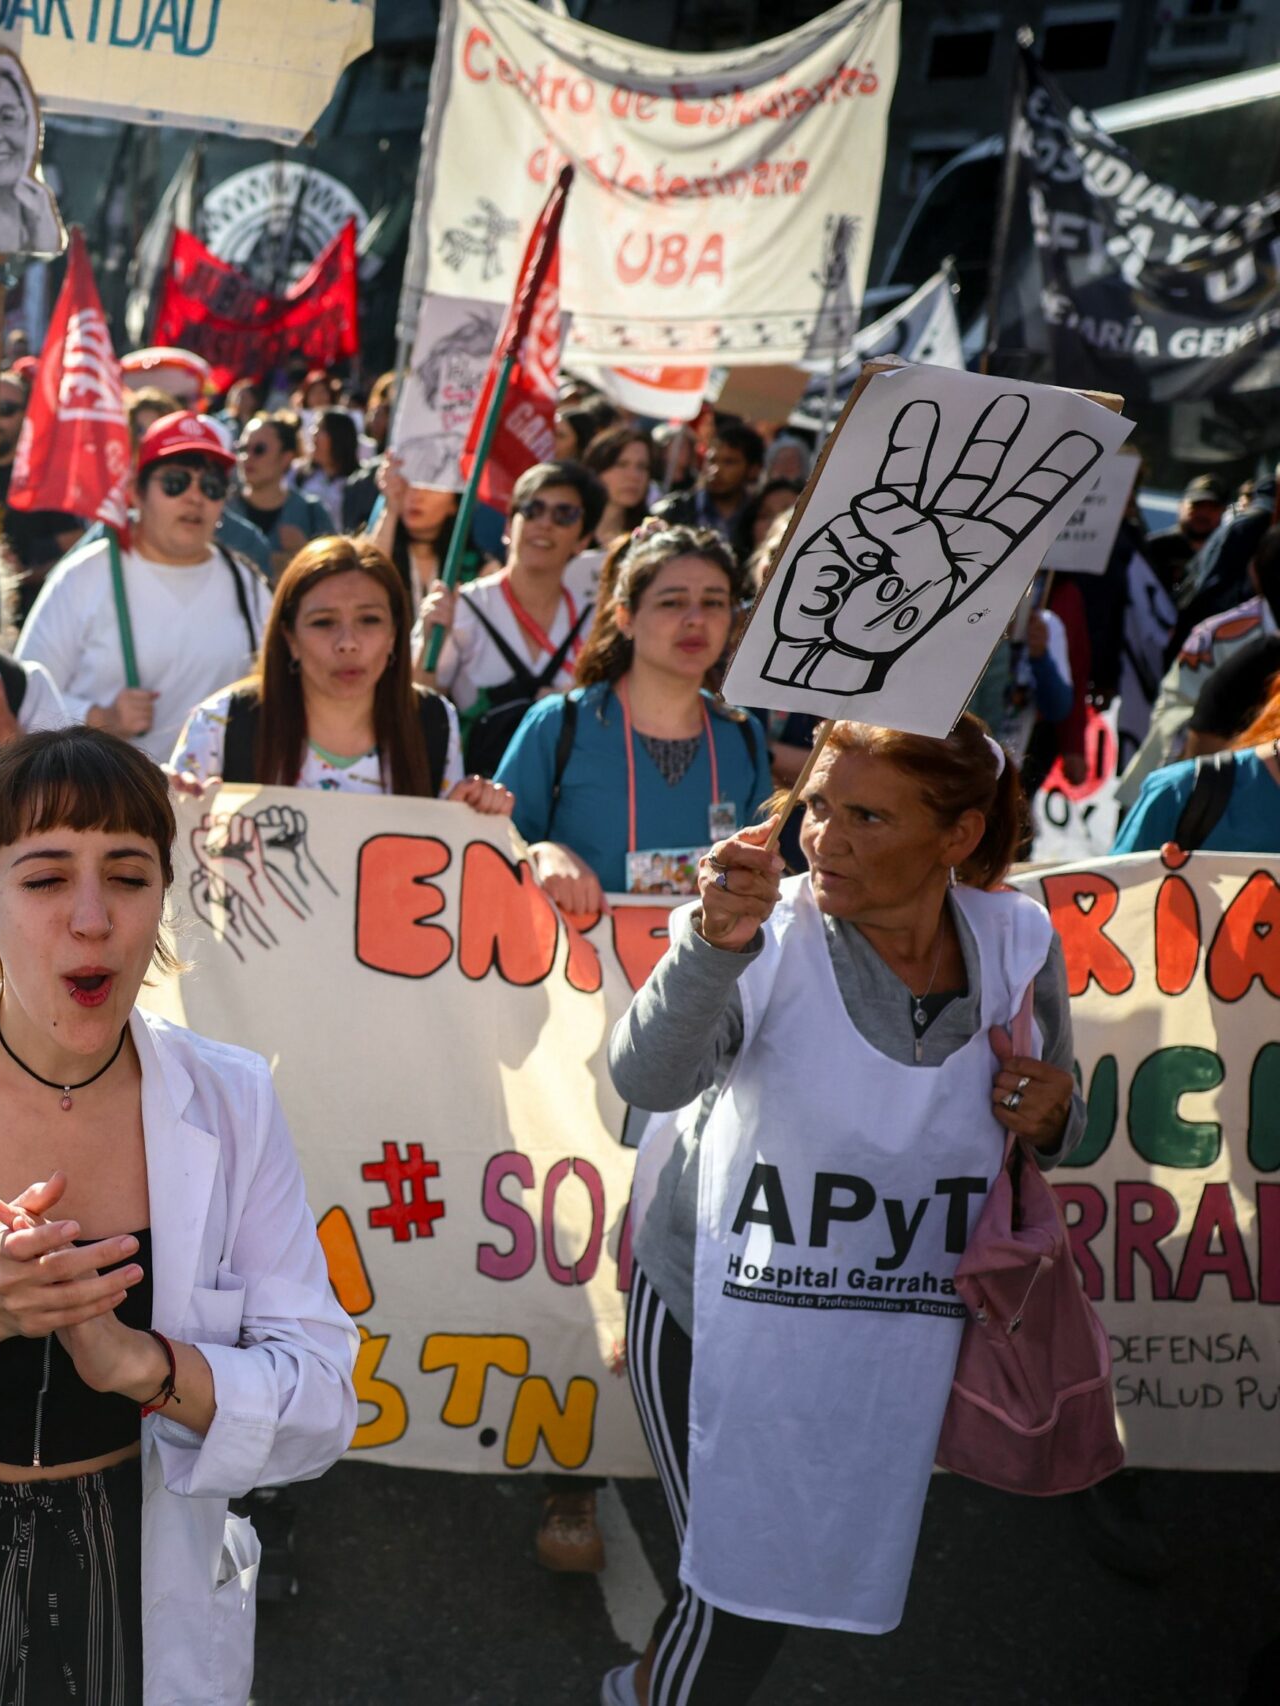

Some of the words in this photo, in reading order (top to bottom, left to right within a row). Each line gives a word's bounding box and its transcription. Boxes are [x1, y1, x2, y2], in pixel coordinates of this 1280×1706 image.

[610, 84, 662, 120] de
[616, 231, 728, 287] UBA
[731, 1162, 988, 1271] APyT
[727, 1252, 838, 1290] Hospital
[846, 1267, 959, 1297] Garraha
[797, 1293, 814, 1308] de
[817, 1296, 902, 1312] Profesionales
[914, 1300, 967, 1318] Técnico
[1108, 1334, 1260, 1364] DEFENSA
[1115, 1375, 1224, 1410] SALUD
